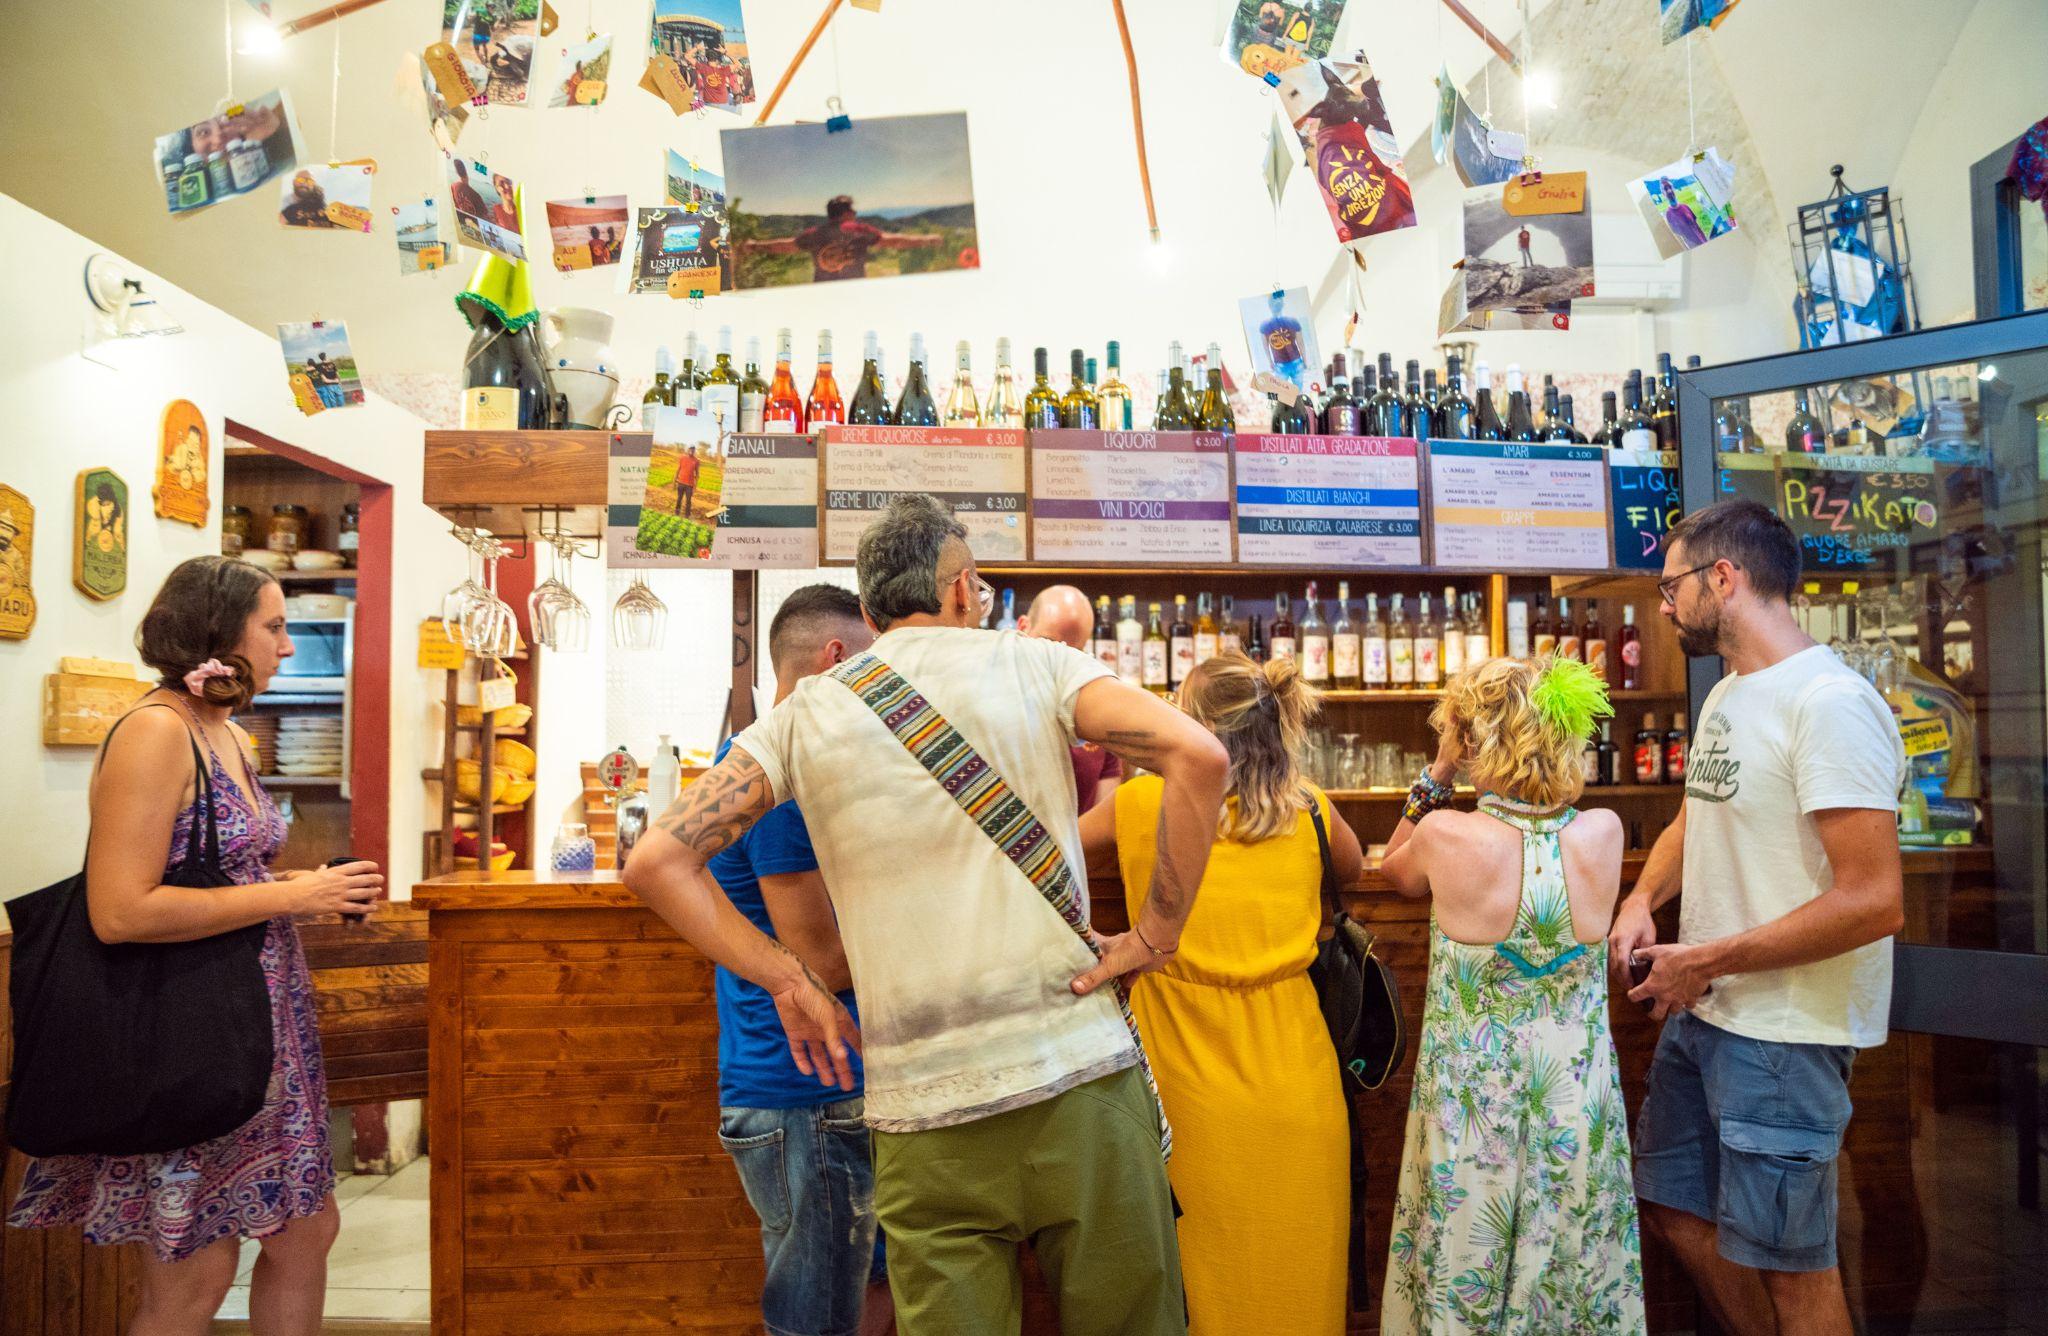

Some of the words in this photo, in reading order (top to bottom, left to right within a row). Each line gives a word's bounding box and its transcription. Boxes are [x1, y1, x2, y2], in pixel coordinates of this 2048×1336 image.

[1332, 171, 1363, 198] SENZA
[1348, 180, 1373, 201] UNA
[650, 256, 708, 270] USHUAIA
[841, 428, 870, 443] CREME
[873, 429, 928, 444] LIQUOROSE
[1103, 433, 1157, 449] LIQUORI
[1260, 437, 1303, 453] DISTILLATI
[1307, 438, 1328, 453] ALTA
[1331, 440, 1391, 456] GRADAZIONE
[1502, 445, 1530, 458] AMARI
[1846, 457, 1857, 469] DA
[1860, 457, 1900, 470] GUSTARE
[829, 492, 862, 509] CREME
[1286, 489, 1330, 504] DISTILLATI
[1333, 490, 1371, 505] BIANCHI
[1099, 500, 1124, 518] VINI
[1129, 501, 1165, 519] DOLCI
[1500, 511, 1536, 525] GRAPPE
[1259, 519, 1285, 533] LINEA
[1287, 519, 1332, 534] LIQUIRIZIA
[1335, 520, 1384, 534] CALABRESE
[727, 537, 762, 545] ICHNUSA
[622, 551, 659, 560] ICHNUSA
